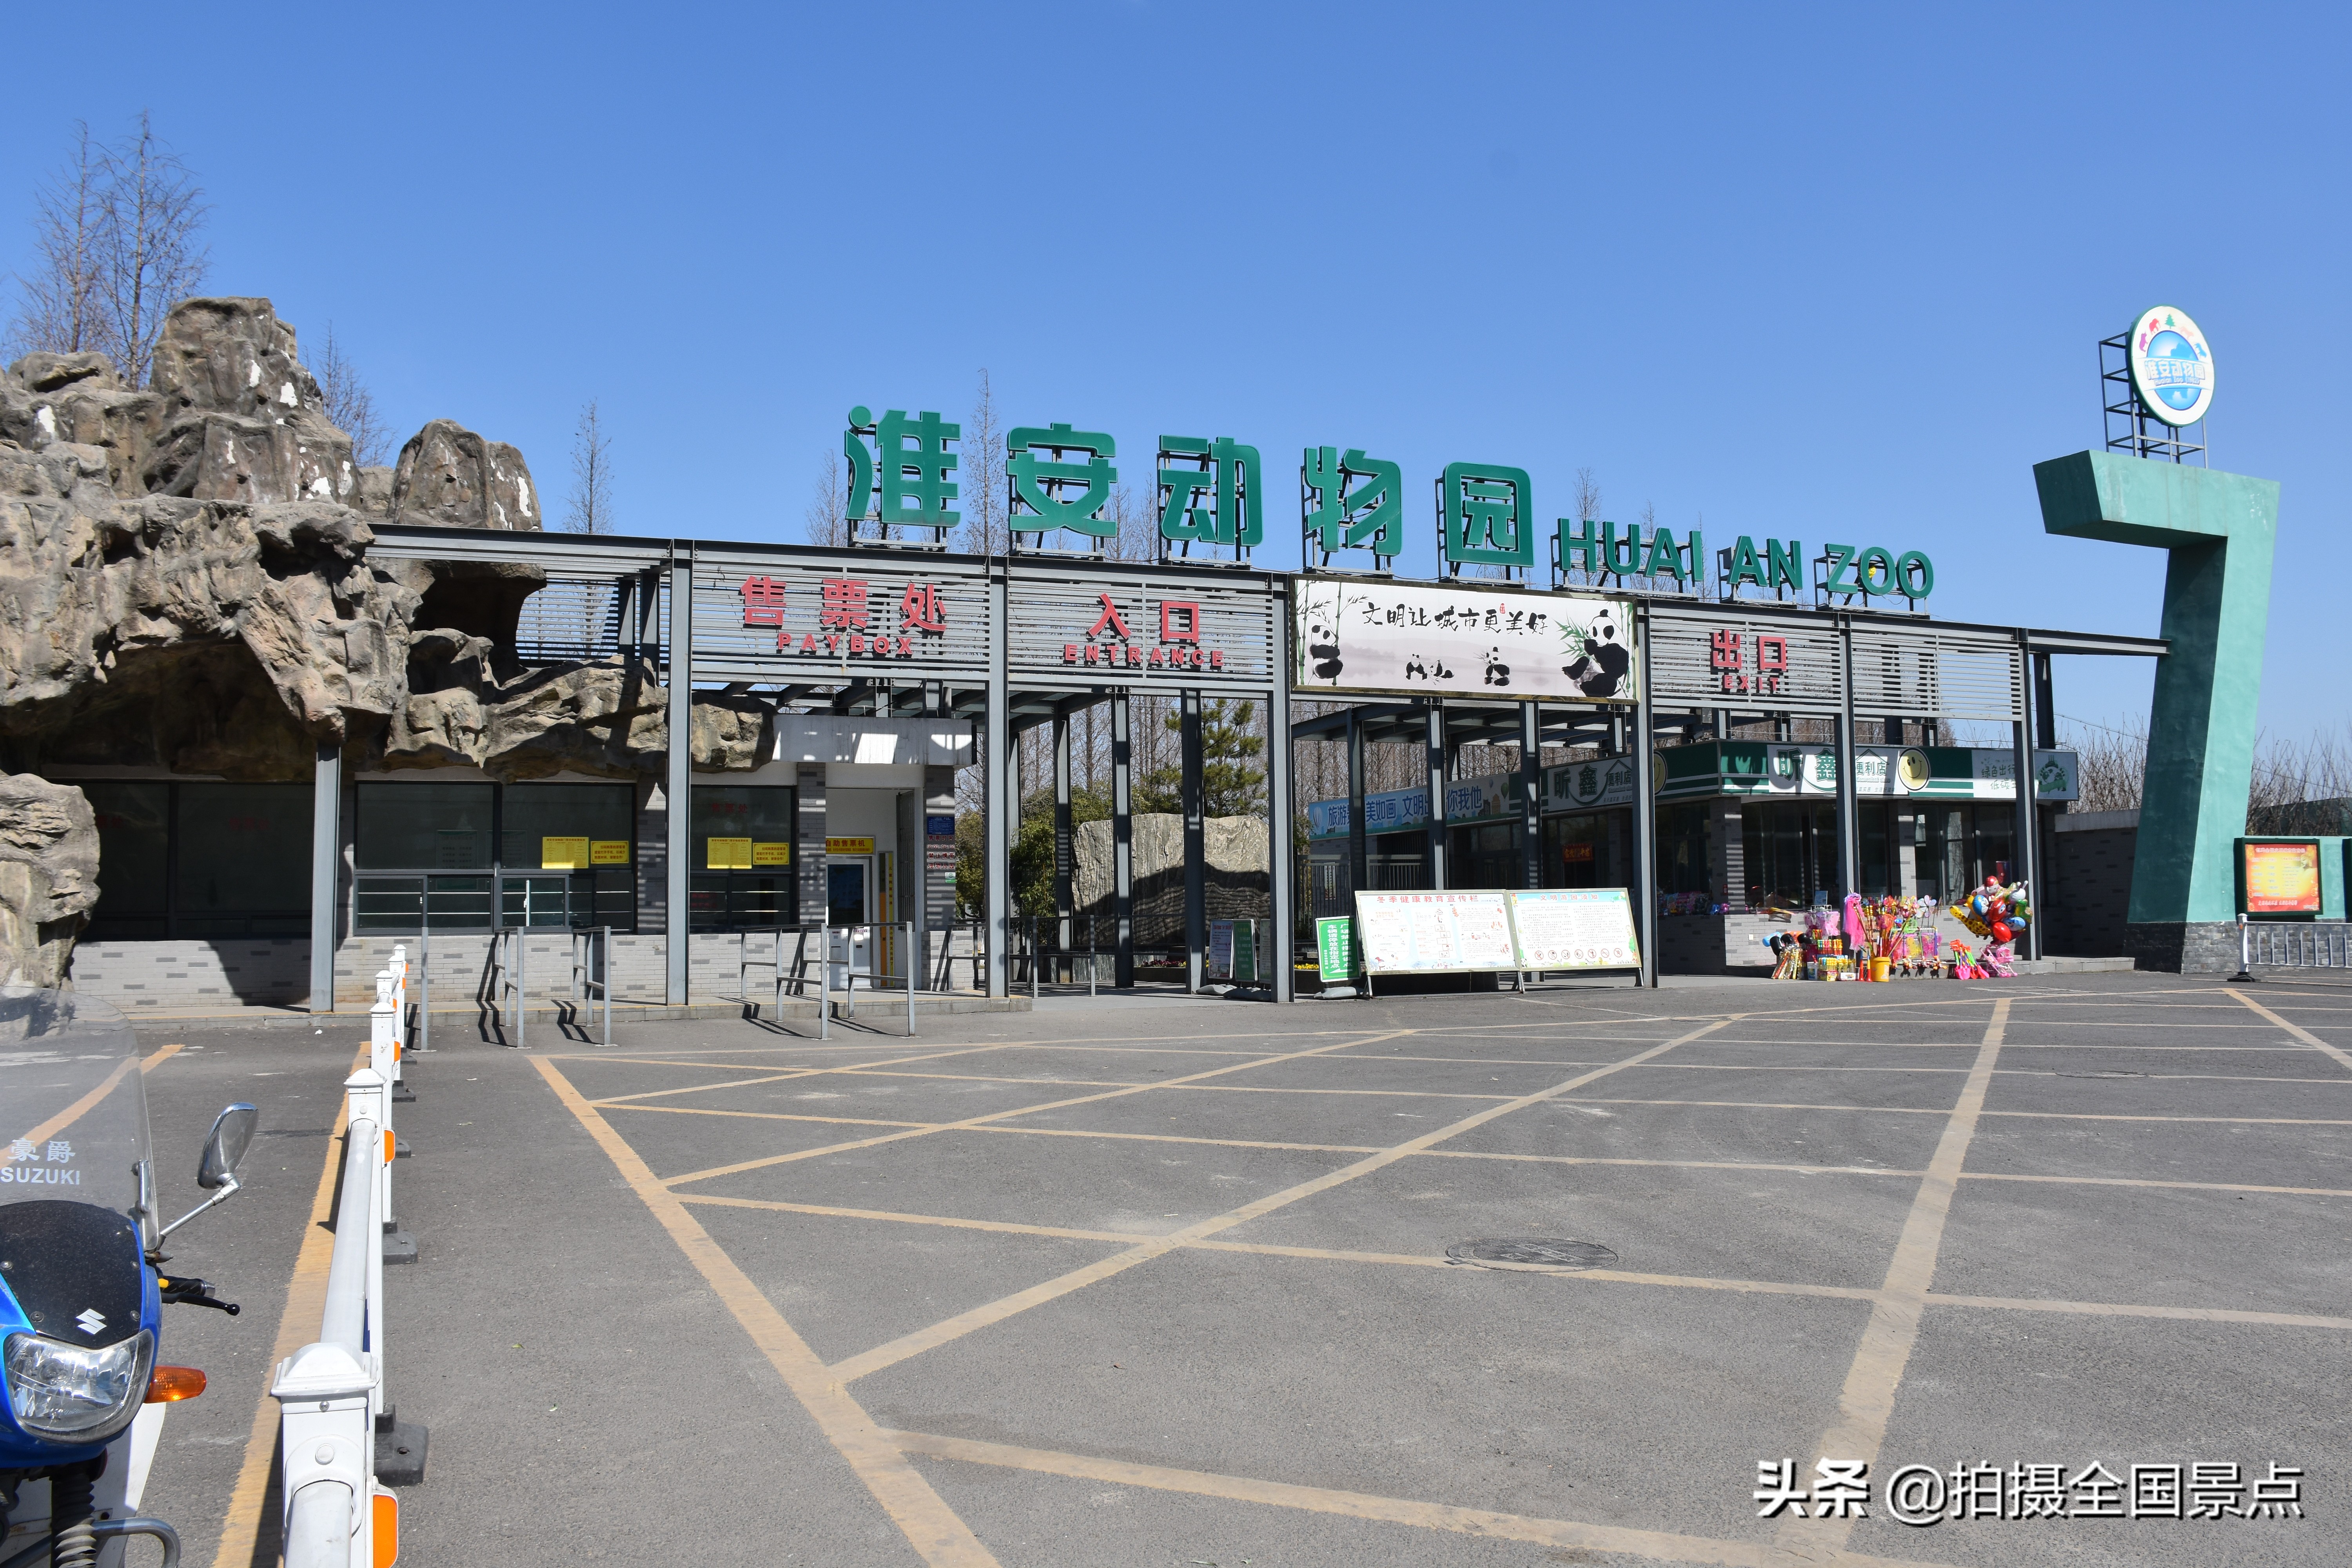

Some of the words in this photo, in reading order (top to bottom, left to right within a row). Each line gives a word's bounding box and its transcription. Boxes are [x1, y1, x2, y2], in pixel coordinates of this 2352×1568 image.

[2144, 360, 2205, 380] 淮安动物园
[844, 405, 1535, 568] 淮安动物园
[1557, 517, 1704, 582] HUAI
[1727, 535, 1802, 590] AN
[1824, 543, 1934, 600] ZOO
[740, 575, 947, 632] 售票处
[1087, 593, 1200, 643] 入口
[1362, 602, 1548, 636] 文明让城市更美好
[777, 633, 913, 655] PAYBOX
[1064, 644, 1224, 667] ENTRANCE
[1712, 630, 1786, 671] 出口
[1724, 675, 1779, 691] EXIT
[1777, 748, 1836, 782] 昕鑫
[1981, 764, 2015, 778] 绿色出行
[1553, 764, 1597, 799] 昕鑫
[1608, 770, 1632, 786] 便利店
[1990, 778, 2016, 790] 低碳生
[1328, 798, 1396, 827] 旅游美如画
[1402, 786, 1482, 818] 文明你我他
[96, 815, 123, 829] 票处
[1377, 895, 1479, 903] 冬季健康教育宣传栏
[1327, 924, 1340, 968] 车辆请停放在指定地点
[7, 1138, 76, 1163] 豪爵
[1, 1167, 80, 1185] SUZUKI
